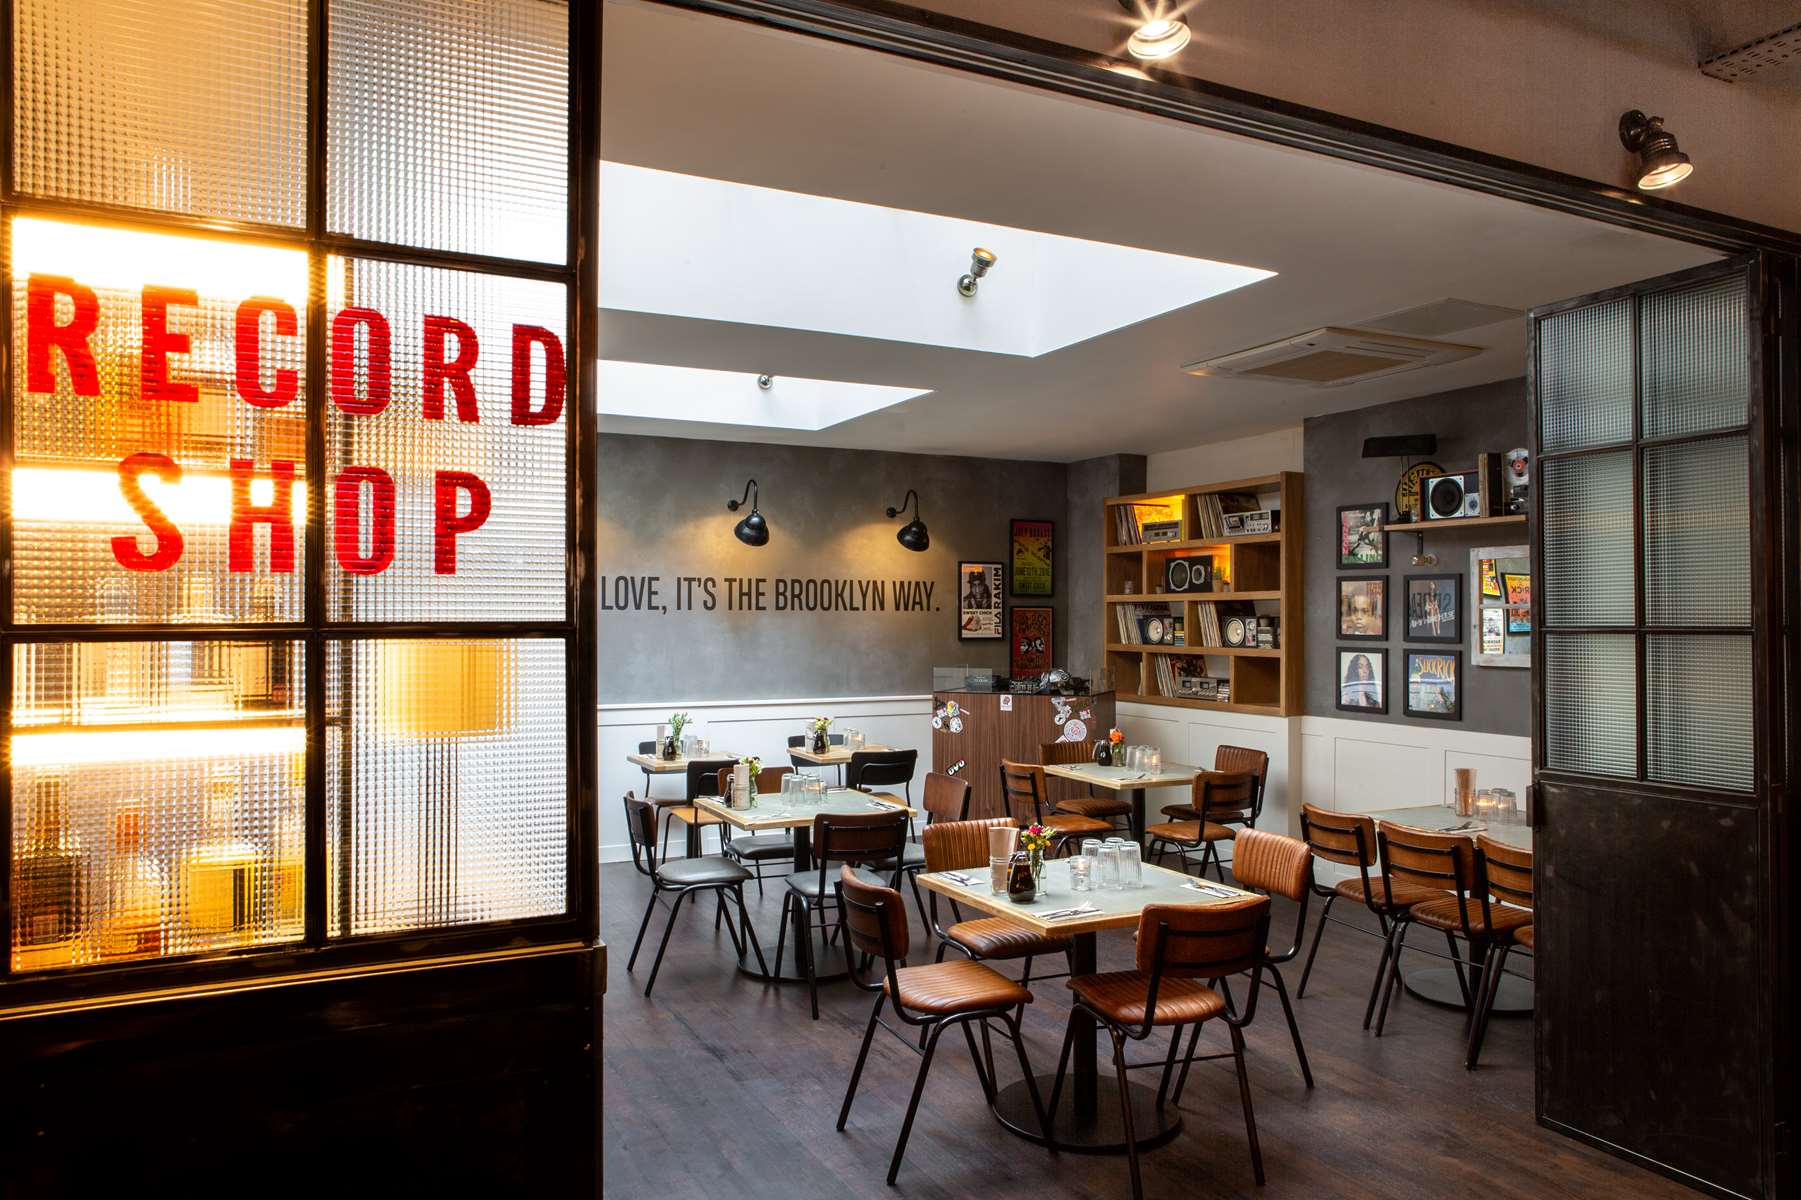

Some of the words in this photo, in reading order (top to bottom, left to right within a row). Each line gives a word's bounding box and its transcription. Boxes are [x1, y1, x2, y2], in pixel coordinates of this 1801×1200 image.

[27, 272, 567, 426] RECORD
[111, 452, 492, 575] SHOP
[601, 576, 667, 615] LOVE,
[676, 577, 716, 611] IT'S
[724, 578, 767, 611] THE
[775, 579, 885, 612] BROOKLYN
[892, 580, 941, 612] WAY.
[993, 567, 1002, 609] RAKIM
[993, 610, 1002, 635] FILA
